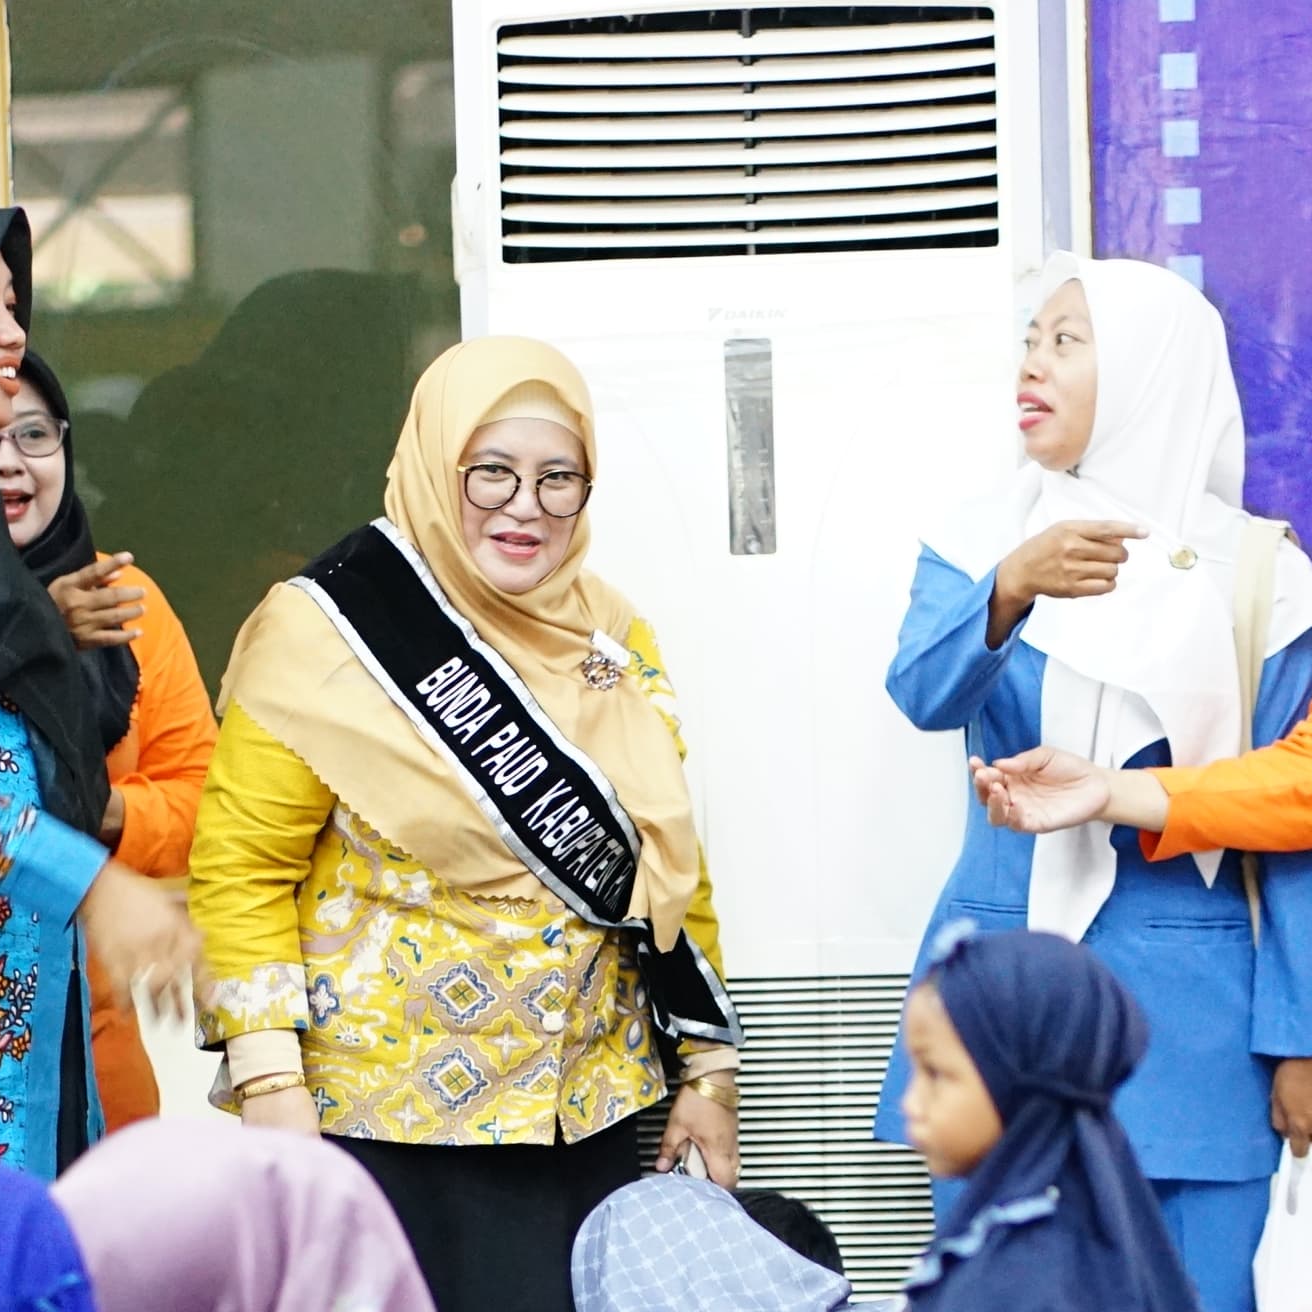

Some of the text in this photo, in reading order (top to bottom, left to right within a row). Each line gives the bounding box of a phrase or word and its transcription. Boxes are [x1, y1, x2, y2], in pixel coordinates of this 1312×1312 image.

[724, 308, 786, 321] DAIKIN
[415, 656, 625, 896] BUNDA PAUD KABUPATEN
